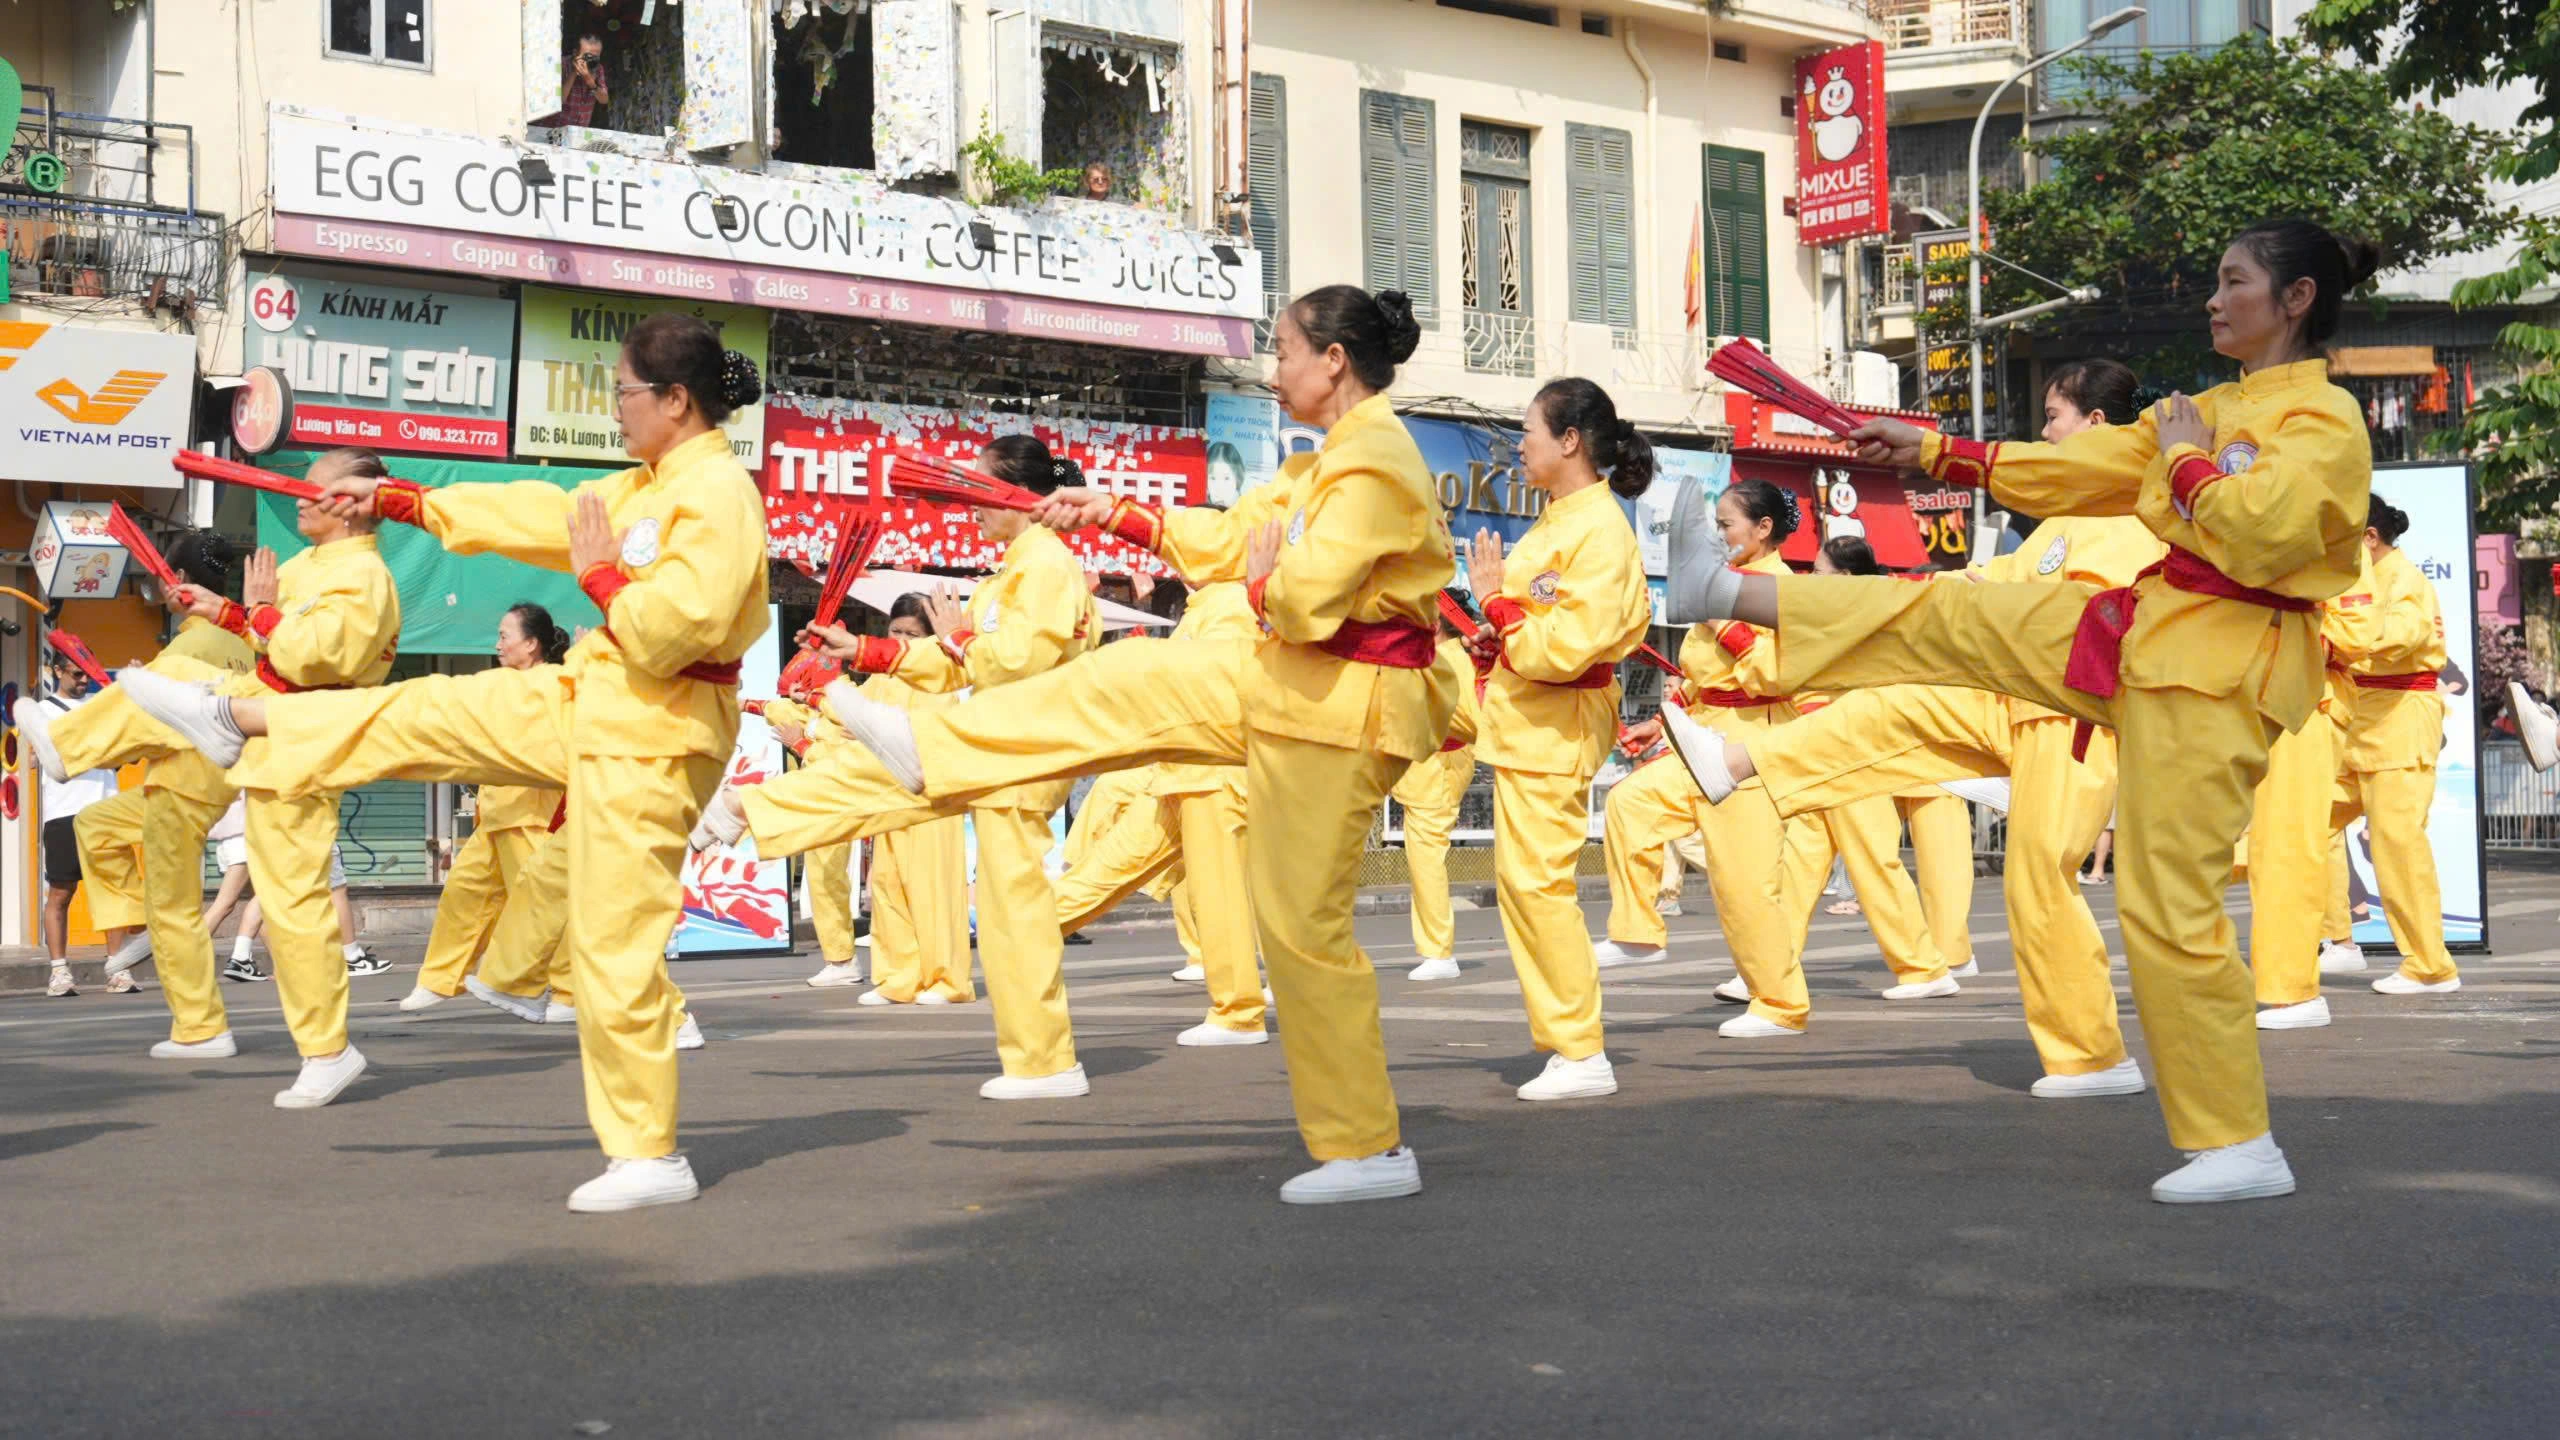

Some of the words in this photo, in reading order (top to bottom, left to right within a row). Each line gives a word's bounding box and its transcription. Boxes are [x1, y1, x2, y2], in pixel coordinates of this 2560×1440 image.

[1800, 163, 1869, 199] MIXUE
[315, 144, 424, 206] EGG
[455, 161, 645, 232] COFFEE
[926, 222, 1081, 283] COFFEE
[1112, 243, 1237, 301] JUICES
[1929, 241, 1972, 261] SAUN
[315, 222, 409, 257] Espresso
[755, 275, 809, 301] Cakes
[847, 286, 910, 313] Snacks
[950, 297, 987, 322] Wifi
[1022, 306, 1141, 338] Airconditioner
[1184, 323, 1228, 347] floors
[253, 287, 296, 321] 64
[319, 287, 389, 321] KÍNH
[390, 293, 449, 326] MẮT
[543, 351, 618, 417] THÀ
[20, 428, 111, 447] VIETNAM
[118, 434, 172, 450] POST
[296, 416, 332, 438] Lương
[358, 420, 382, 437] Can
[553, 426, 568, 445] 64
[571, 428, 606, 449] Lương
[769, 440, 869, 496] THE
[943, 511, 969, 525] post
